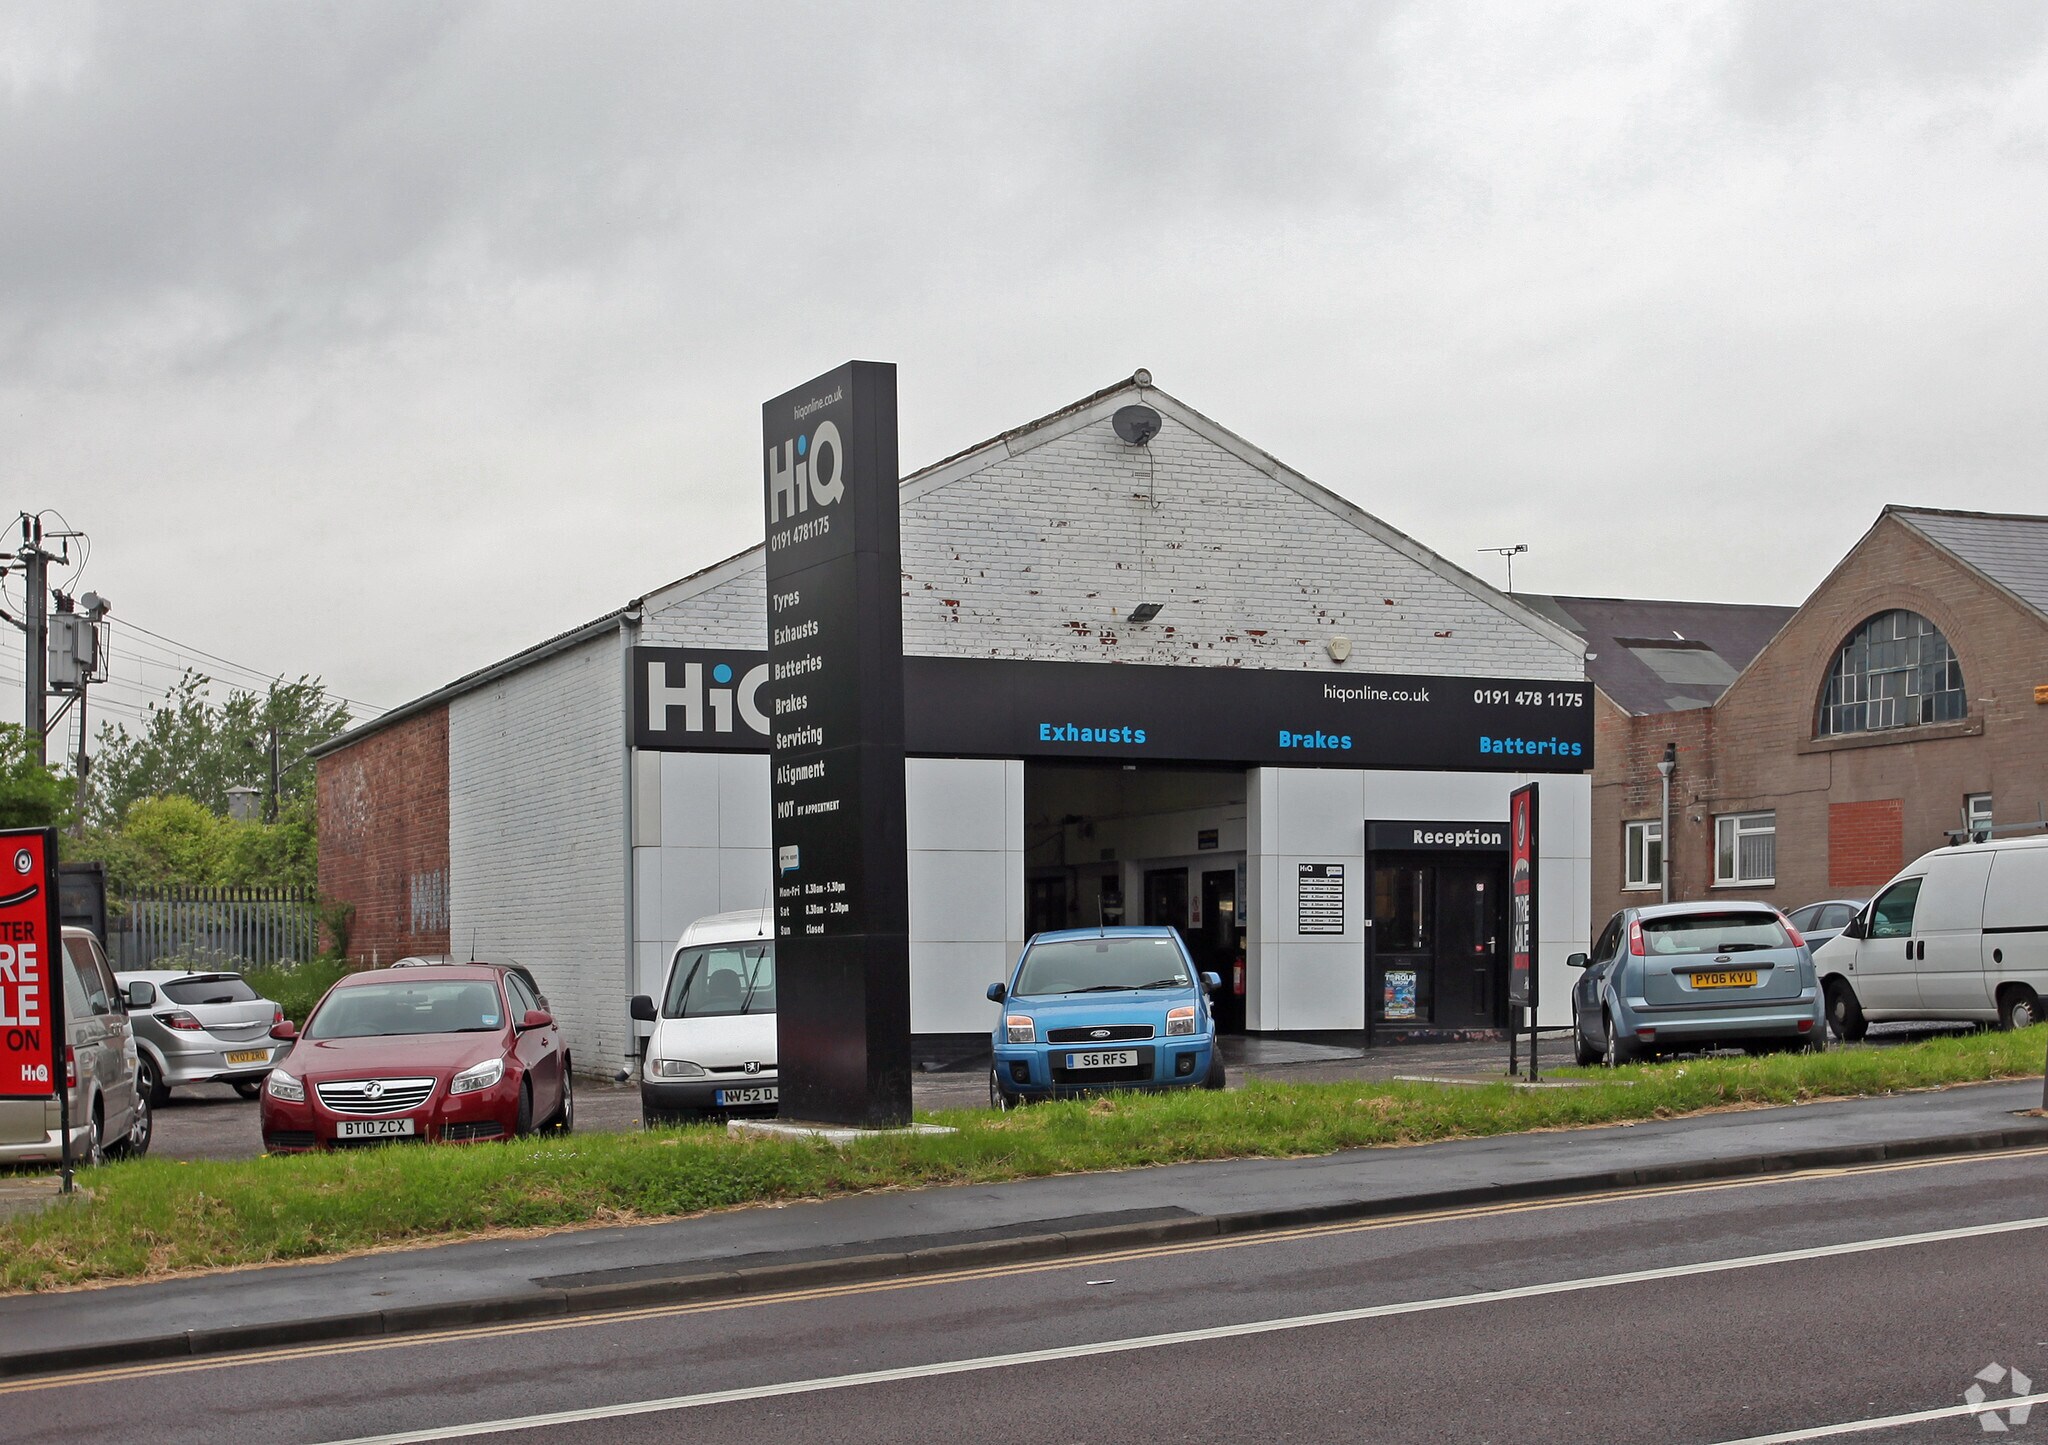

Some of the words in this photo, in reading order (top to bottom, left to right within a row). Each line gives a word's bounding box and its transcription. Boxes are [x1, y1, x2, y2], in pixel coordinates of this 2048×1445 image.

[793, 386, 843, 420] hiqonline.co.uk
[769, 420, 845, 524] HiQ
[771, 532, 791, 551] 0191
[793, 516, 830, 542] 4781175
[773, 590, 800, 613] Tyres
[774, 620, 819, 646] Exhausts
[774, 654, 822, 681] Batteries
[1323, 683, 1430, 702] hiqonline.co.uk
[1473, 689, 1510, 704] 0191
[1514, 691, 1543, 706] 478
[1547, 693, 1583, 707] 1175
[775, 694, 808, 716] Brakes
[776, 725, 823, 750] Servicing
[1039, 723, 1146, 744] Exhausts
[1278, 730, 1352, 749] Brakes
[1479, 736, 1582, 756] Batteries
[777, 759, 825, 786] Alignment
[777, 800, 795, 819] MOT
[797, 805, 805, 816] BY
[805, 800, 840, 815] APPOINTMENT
[1413, 829, 1501, 847] Reception
[780, 906, 790, 917] Sat
[806, 923, 825, 934] Closed
[1696, 973, 1726, 985] PY06
[1729, 972, 1752, 983] KYU
[6, 1029, 40, 1051] ON
[1083, 1054, 1099, 1066] S6
[1103, 1052, 1127, 1065] RFS
[21, 1064, 48, 1082] HiQ
[725, 1089, 760, 1102] NV52
[345, 1122, 375, 1135] BT10
[379, 1120, 405, 1133] ZCX
